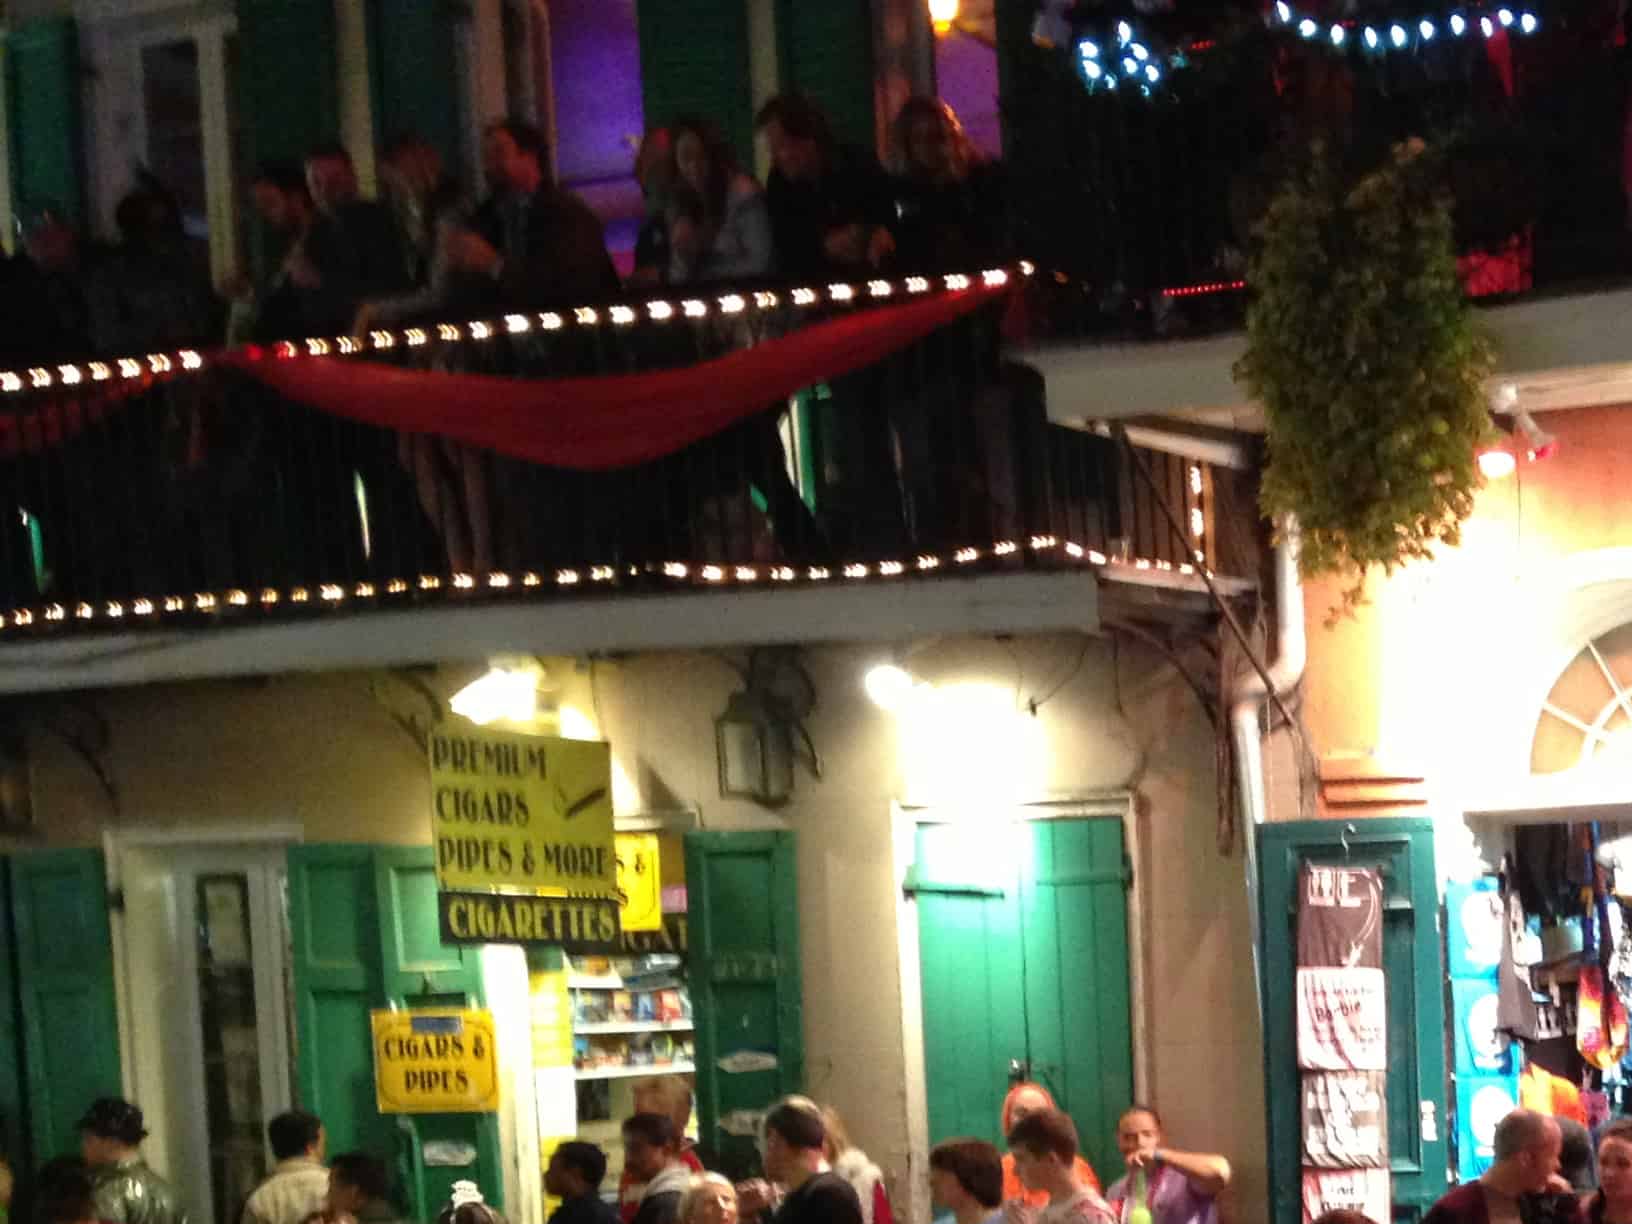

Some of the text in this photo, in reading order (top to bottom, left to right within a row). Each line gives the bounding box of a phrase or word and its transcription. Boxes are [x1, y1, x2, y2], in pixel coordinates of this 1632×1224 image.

[433, 736, 546, 780] PREMIUM
[436, 786, 529, 827] CIGARS
[438, 837, 512, 874] PIPES
[522, 841, 535, 876] &
[544, 843, 607, 877] MORE
[449, 897, 615, 942] CIGARETTES
[384, 1034, 485, 1060] CIGARS &
[405, 1069, 468, 1094] PIPES
